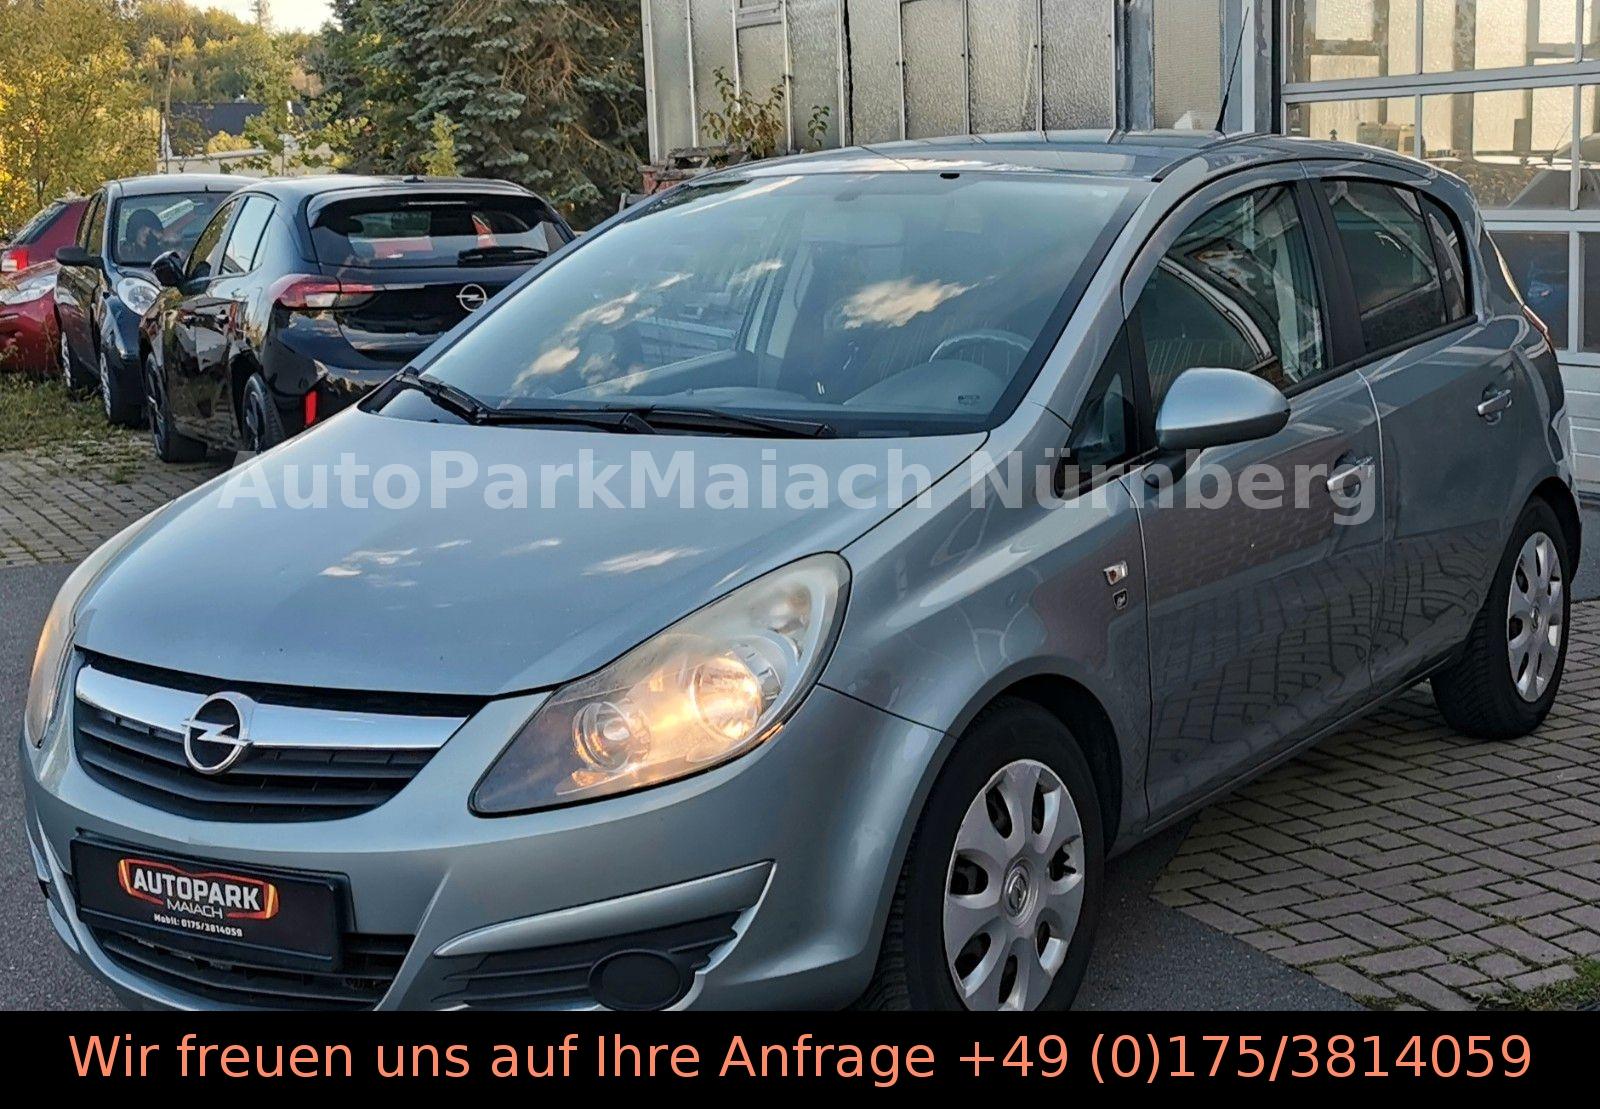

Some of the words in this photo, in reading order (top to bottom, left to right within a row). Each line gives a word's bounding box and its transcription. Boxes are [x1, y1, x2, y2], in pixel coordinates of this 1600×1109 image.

[133, 868, 260, 911] AUTOPARK
[166, 898, 223, 919] MAIACH
[181, 917, 243, 937] 0175/3814059
